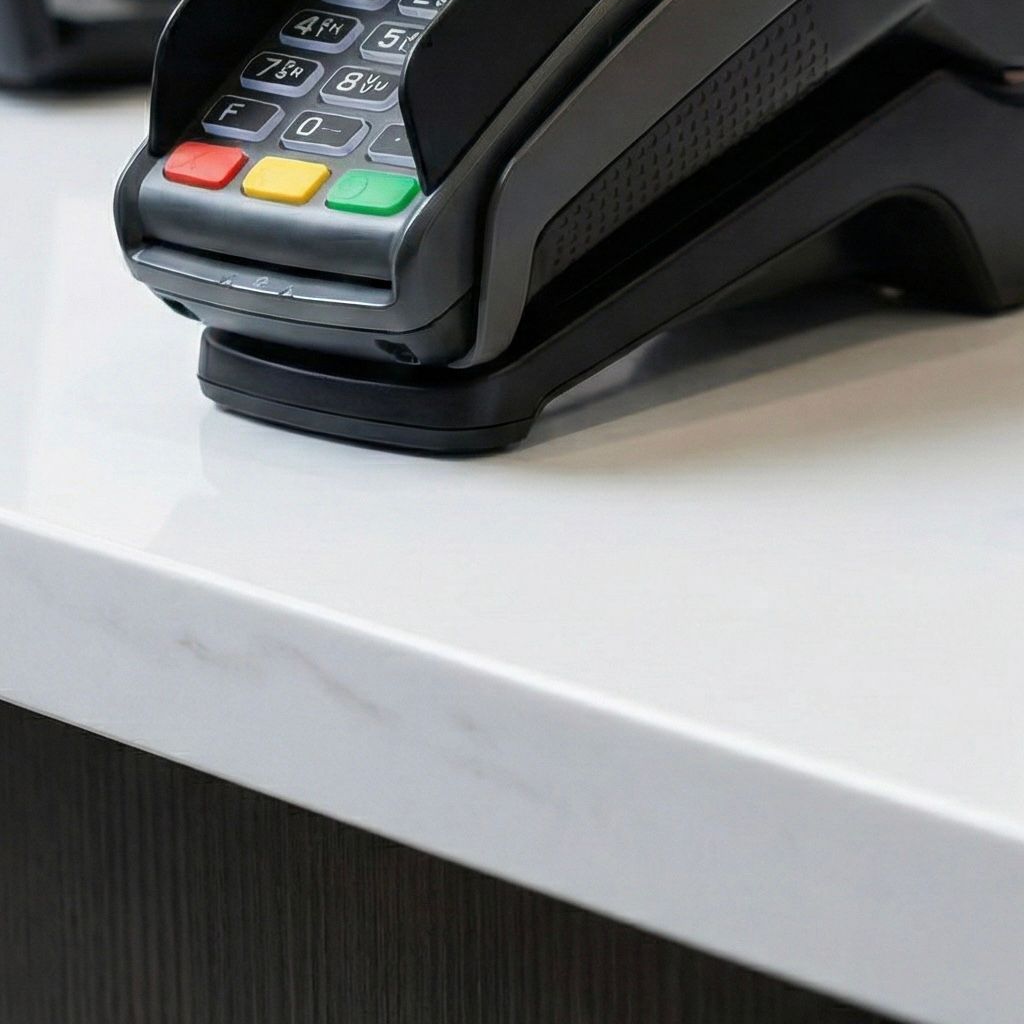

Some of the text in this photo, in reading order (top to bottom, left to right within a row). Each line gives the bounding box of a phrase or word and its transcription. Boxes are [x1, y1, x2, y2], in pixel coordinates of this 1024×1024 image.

[294, 16, 320, 36] 4
[378, 28, 406, 49] 5
[256, 57, 283, 77] 7
[336, 72, 364, 92] 8
[218, 103, 246, 121] F
